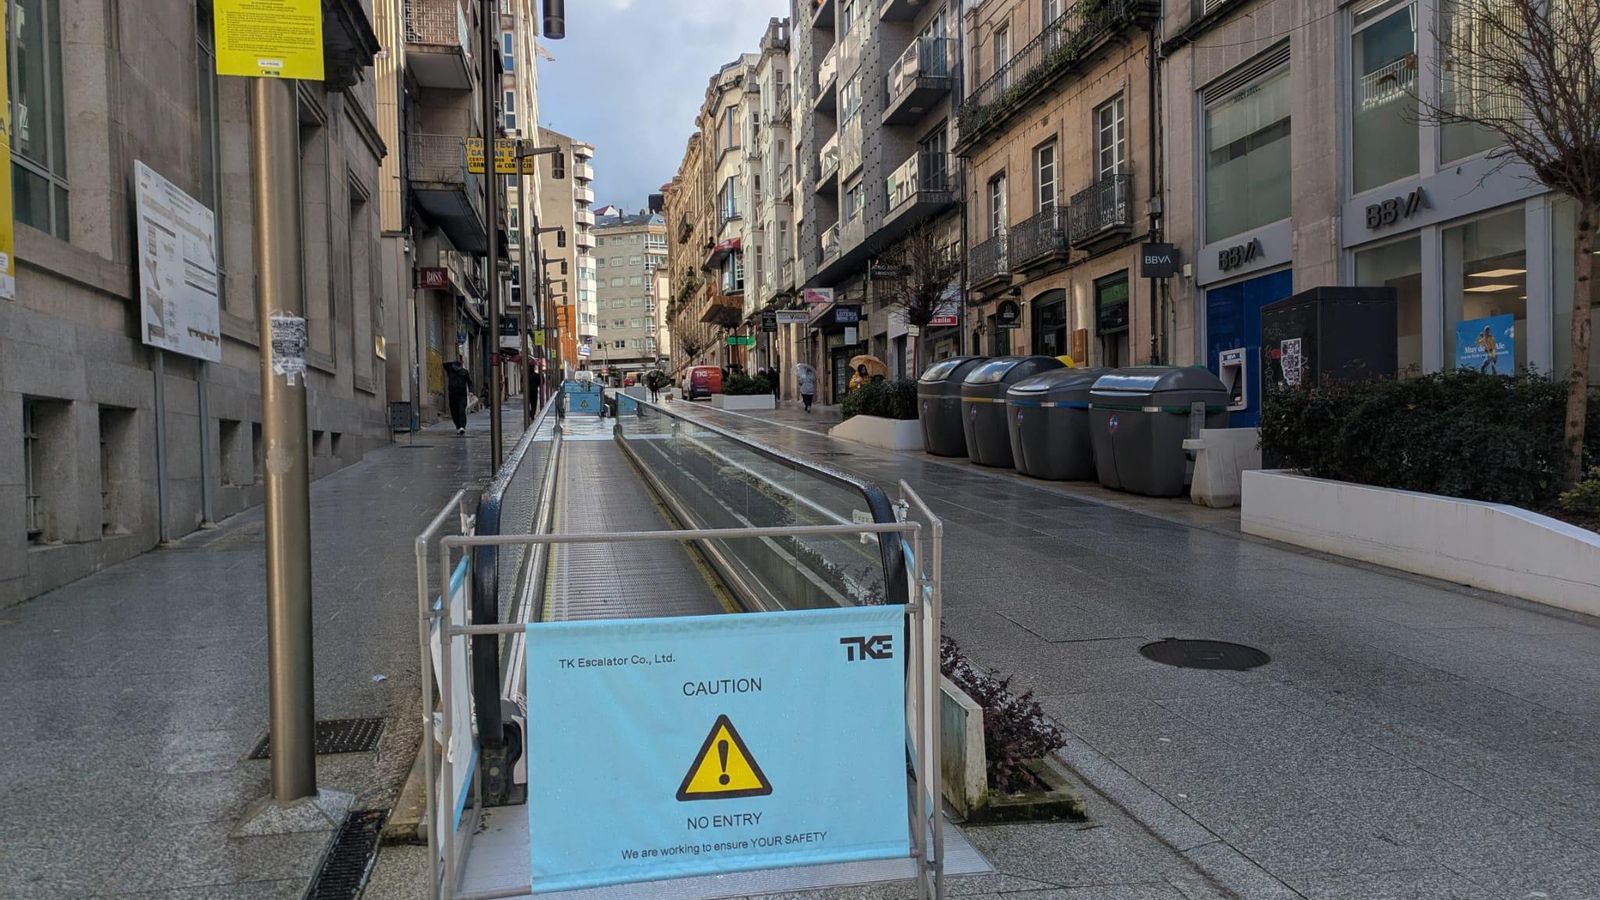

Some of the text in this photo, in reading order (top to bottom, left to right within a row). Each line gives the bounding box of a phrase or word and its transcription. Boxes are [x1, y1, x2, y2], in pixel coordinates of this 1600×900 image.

[1366, 186, 1431, 229] BBVA
[1145, 255, 1171, 264] BBVA
[1218, 237, 1264, 271] BBVA
[839, 635, 893, 661] TKE
[559, 653, 676, 669] TK Escalator Co., Ltd.
[682, 677, 762, 696] CAUTION
[687, 812, 763, 830] NO ENTRY
[621, 831, 827, 860] We are working to ensure YOUR SAFETY
